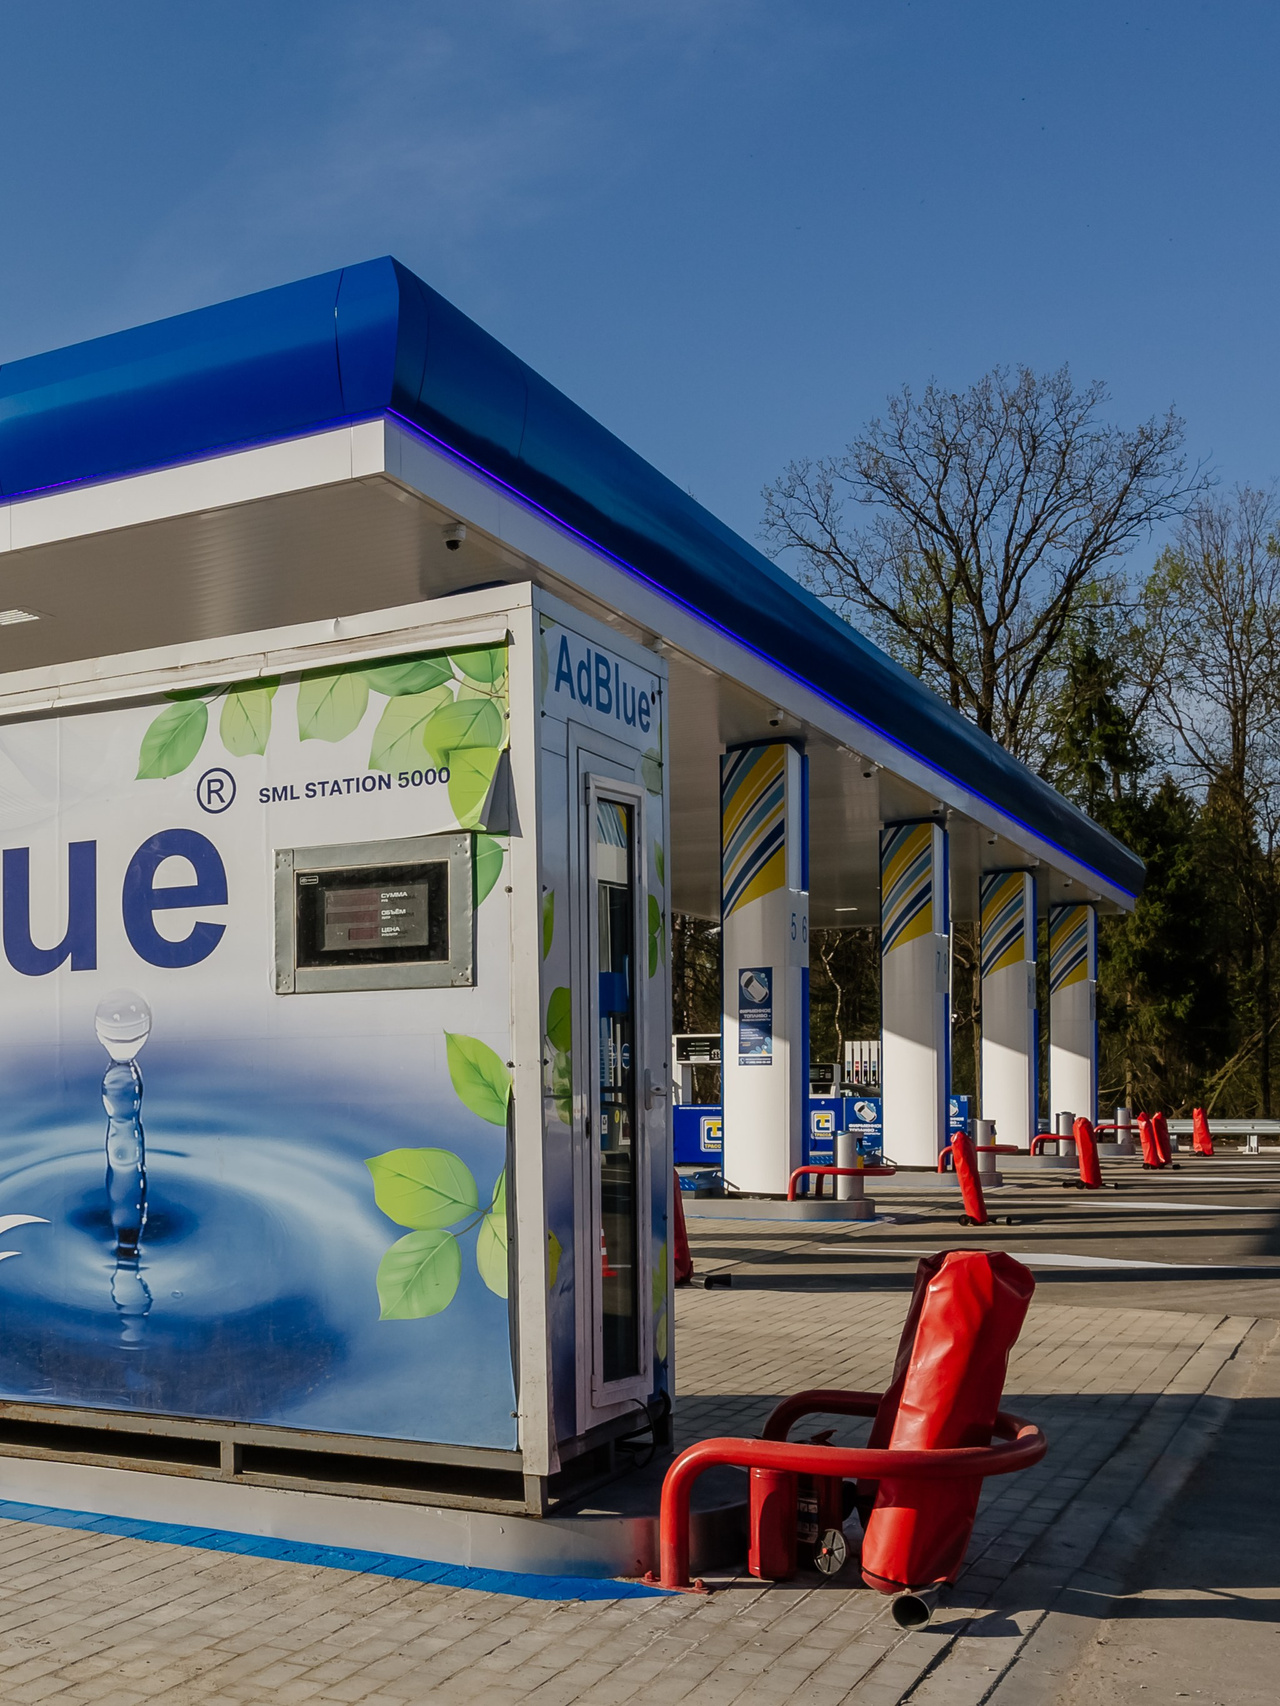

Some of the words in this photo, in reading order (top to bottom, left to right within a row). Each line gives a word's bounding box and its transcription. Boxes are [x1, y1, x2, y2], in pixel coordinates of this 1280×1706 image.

[554, 634, 651, 733] AdBlue
[258, 784, 300, 804] SML
[305, 773, 392, 799] STATION
[397, 767, 451, 789] 5000
[790, 912, 797, 941] 5
[801, 916, 808, 944] 6
